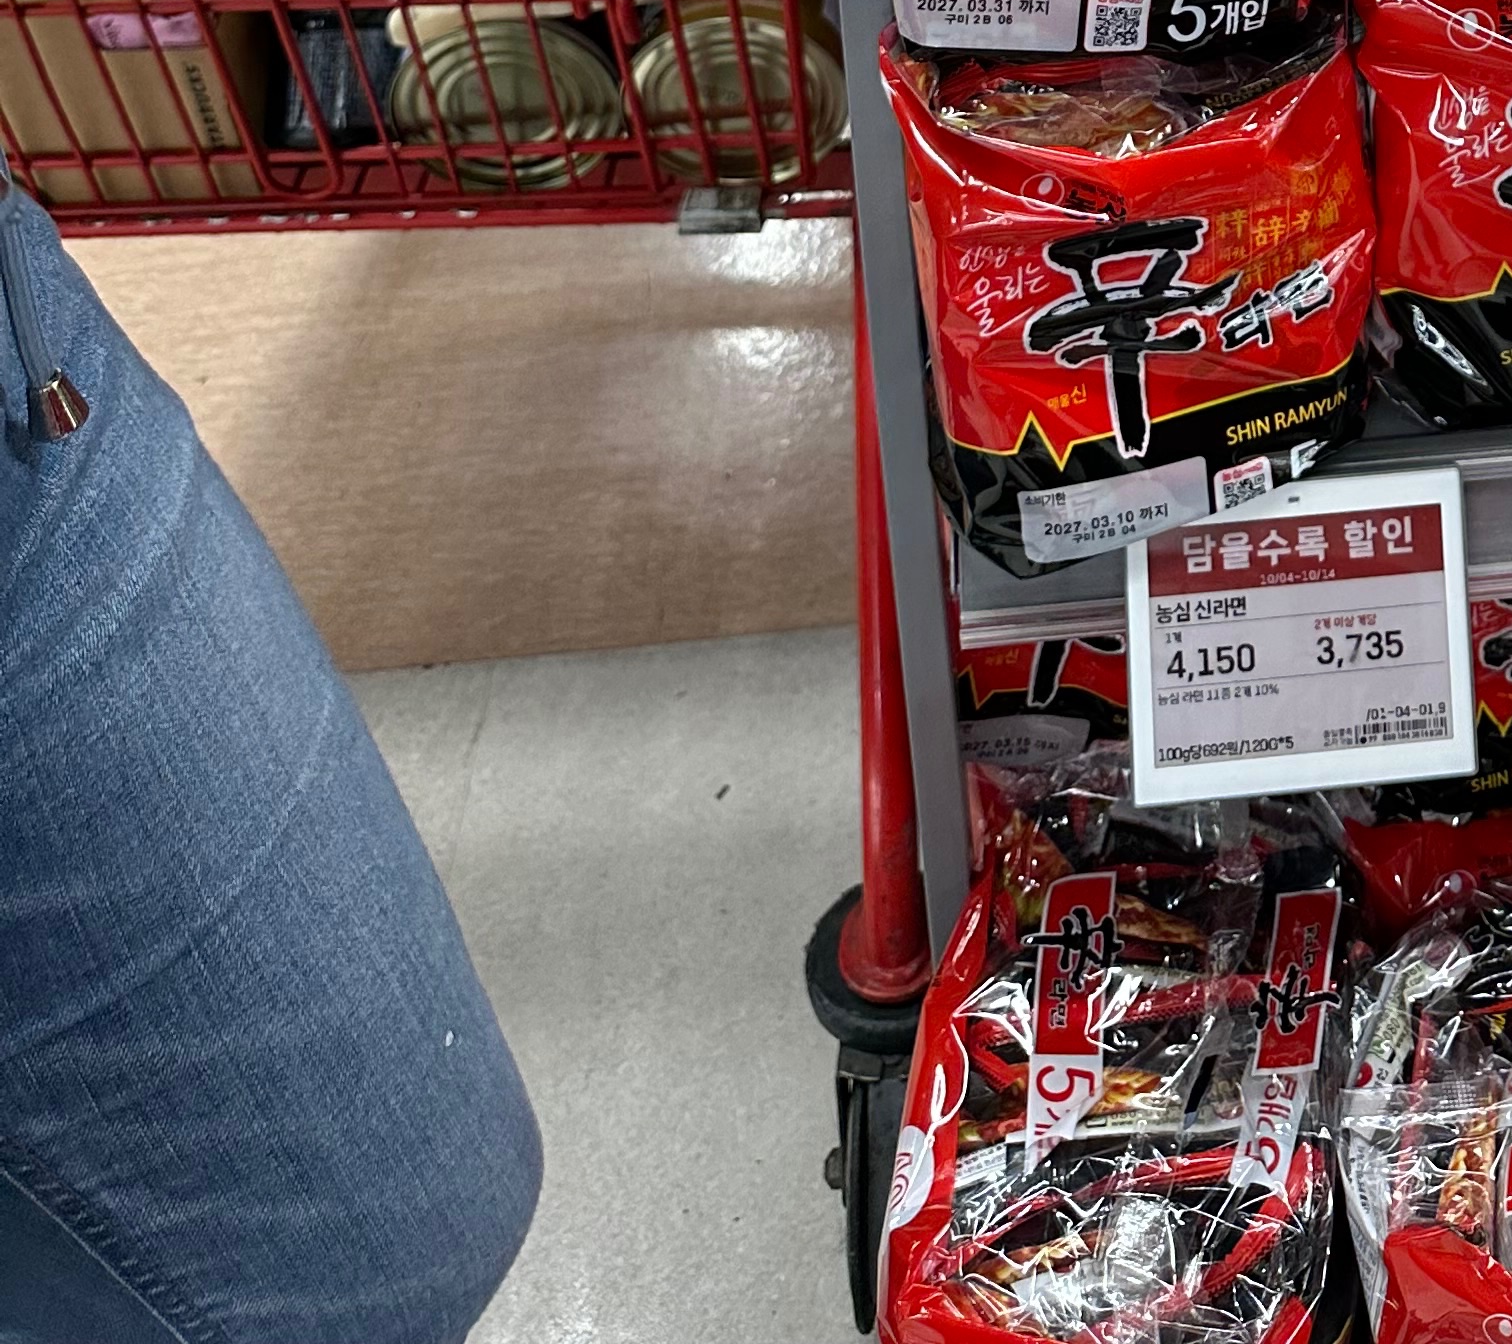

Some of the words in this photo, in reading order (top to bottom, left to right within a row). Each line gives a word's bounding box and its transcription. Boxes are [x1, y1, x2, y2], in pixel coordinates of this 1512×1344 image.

[1019, 0, 1050, 15] 까지
[945, 14, 969, 25] 구미
[973, 15, 991, 24] 2B
[998, 15, 1013, 24] 06
[1024, 216, 1240, 458] 辛
[1226, 415, 1271, 446] SHIN
[1273, 388, 1348, 431] RAMYUN
[1024, 491, 1066, 507] 소비기한
[1139, 503, 1169, 521] 까지
[1072, 529, 1096, 543] 구미
[1121, 523, 1136, 536] 04
[1182, 525, 1329, 574] 담을수록
[1344, 515, 1414, 559] 할인
[1156, 602, 1191, 623] 농심
[1194, 596, 1247, 621] 신라면
[1314, 618, 1332, 630] 2개
[1333, 616, 1354, 628] 이상
[1165, 632, 1182, 644] 1개
[1316, 630, 1404, 668] 3,735
[1166, 643, 1256, 682] 4,150
[1158, 692, 1179, 705] 농심
[1182, 690, 1204, 703] 라면
[1255, 683, 1279, 696] 10%
[1470, 771, 1510, 794] SHIN
